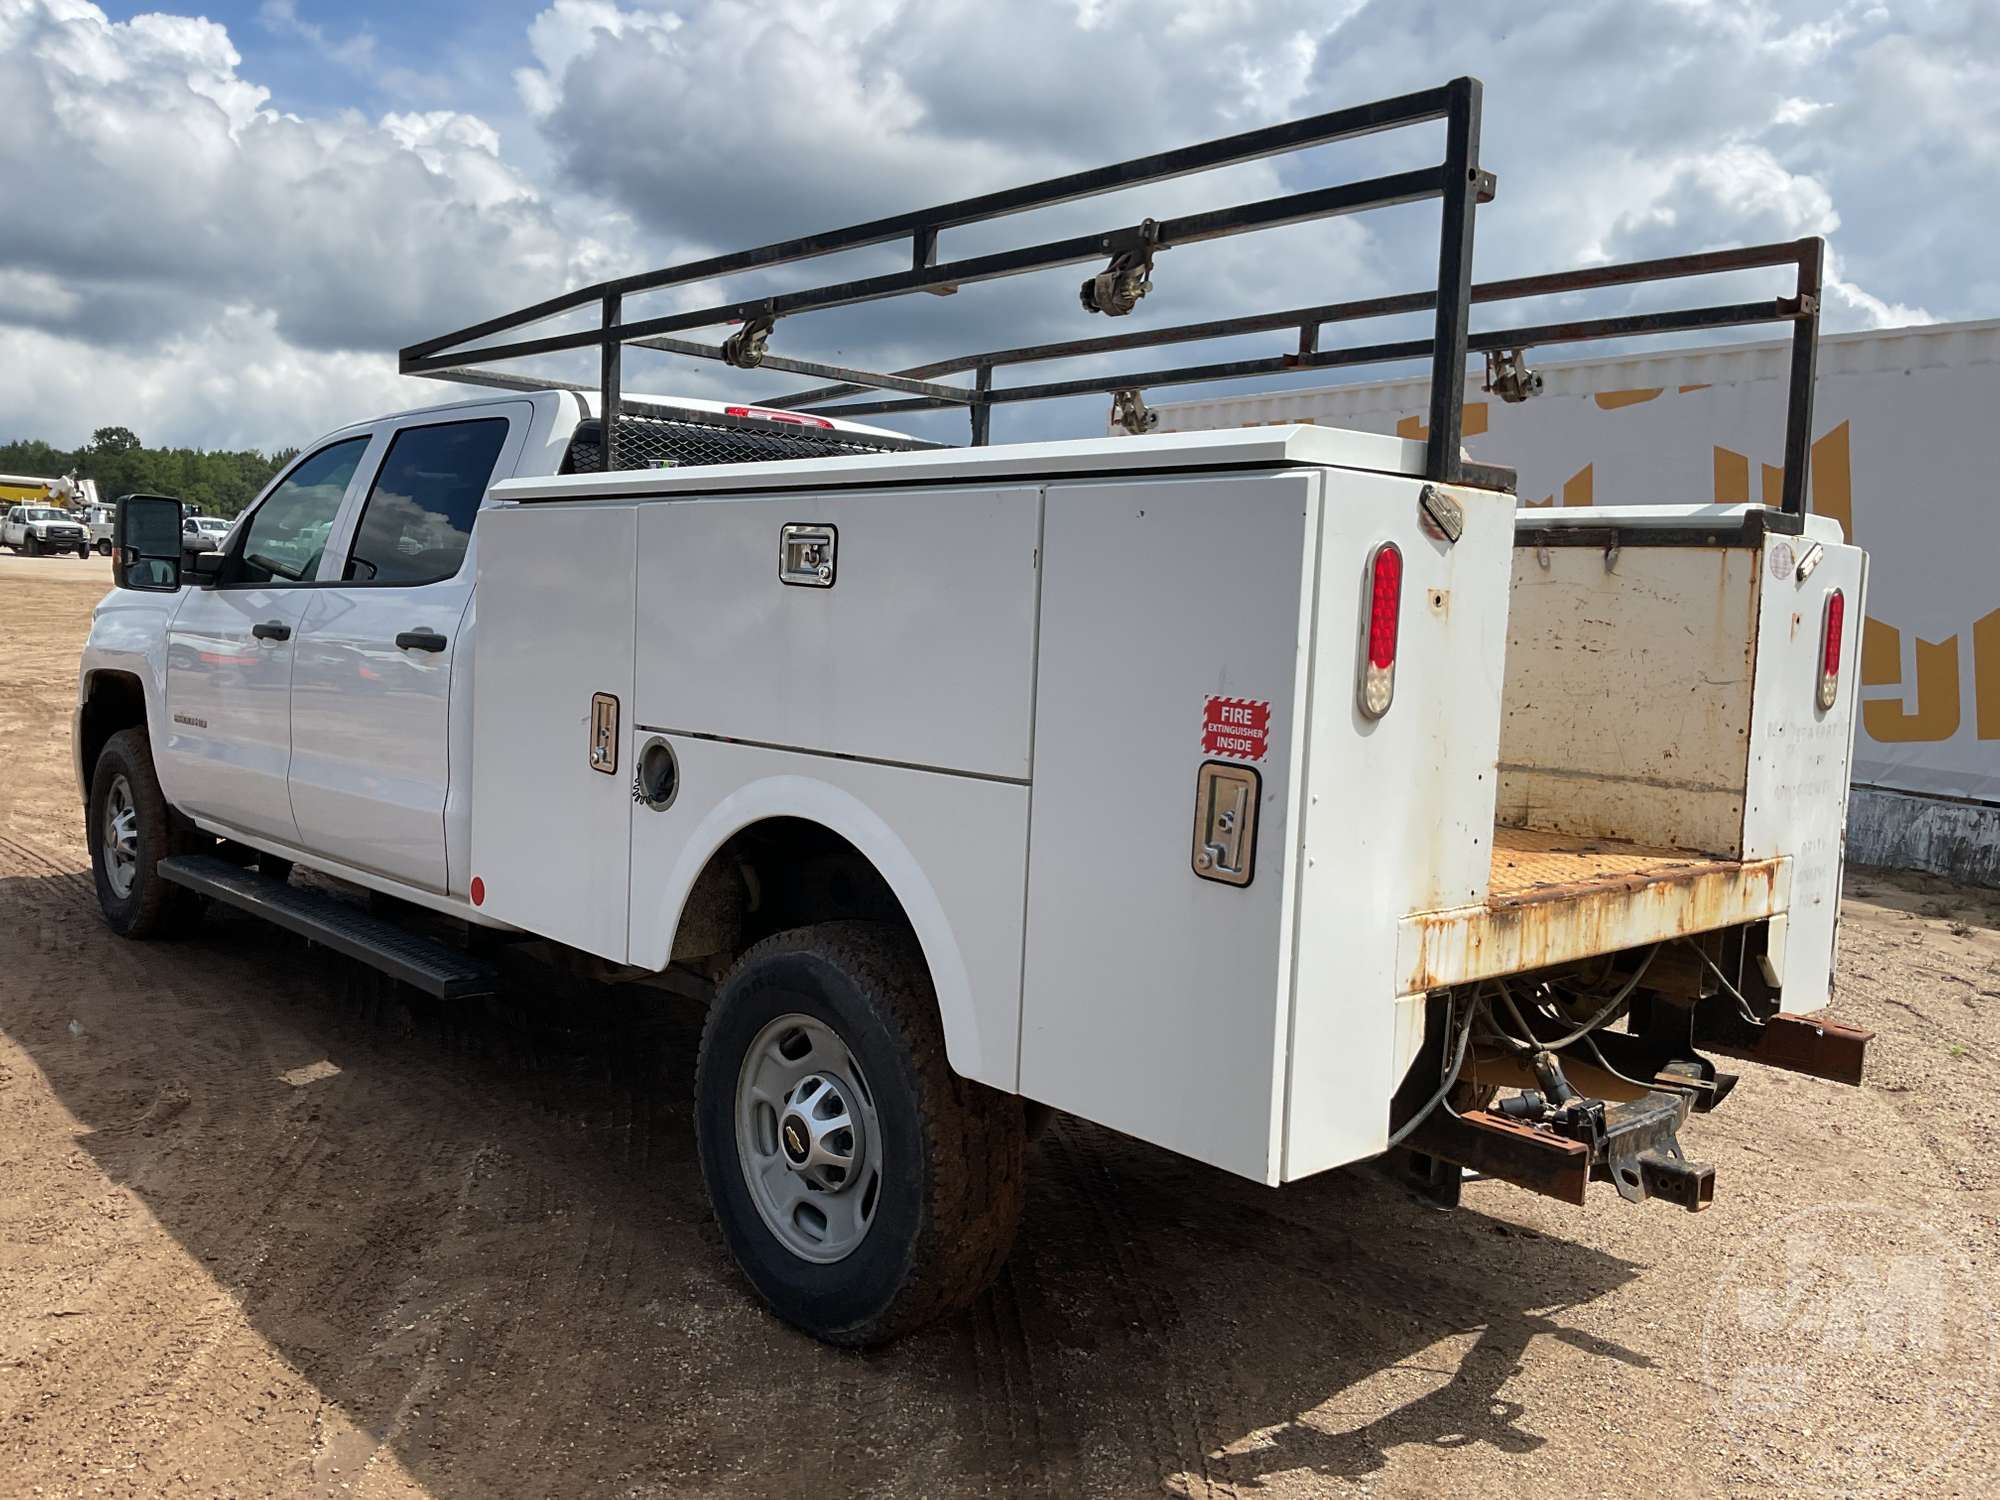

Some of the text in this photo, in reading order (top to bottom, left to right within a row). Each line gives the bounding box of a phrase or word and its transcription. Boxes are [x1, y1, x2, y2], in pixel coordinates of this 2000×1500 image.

[1221, 706, 1252, 725] FIRE
[1208, 722, 1264, 738] EXTINGUISHER
[1216, 736, 1253, 752] INSIDE
